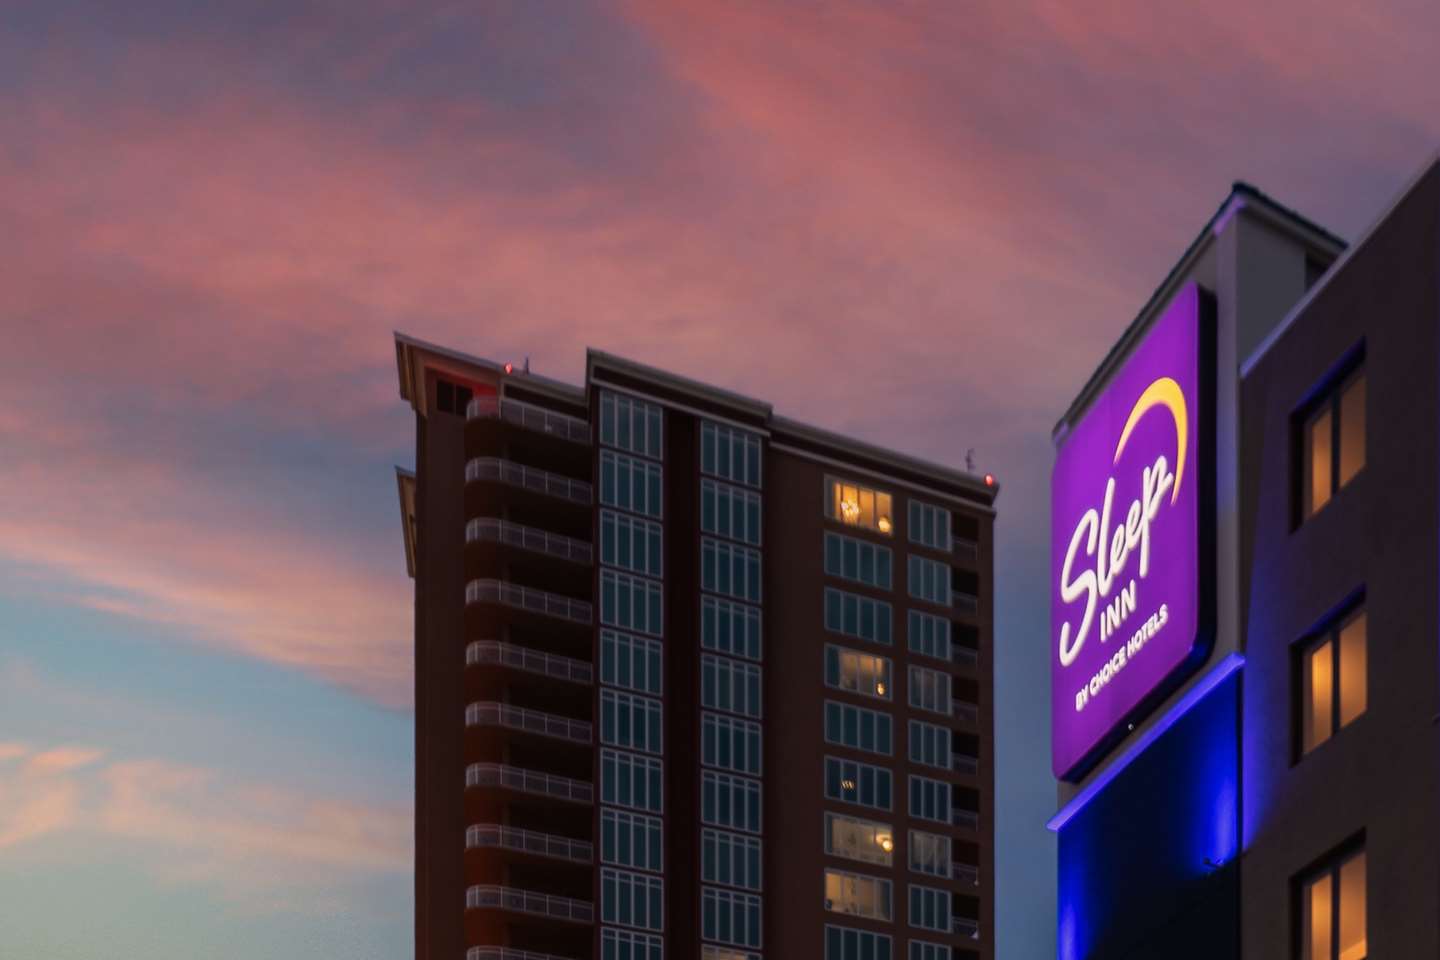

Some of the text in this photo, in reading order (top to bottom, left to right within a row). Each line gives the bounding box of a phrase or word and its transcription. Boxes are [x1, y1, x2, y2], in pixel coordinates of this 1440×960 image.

[1059, 455, 1174, 666] Sleep
[1100, 579, 1136, 642] INN
[1075, 604, 1169, 711] BY CHOICE HOTELS
